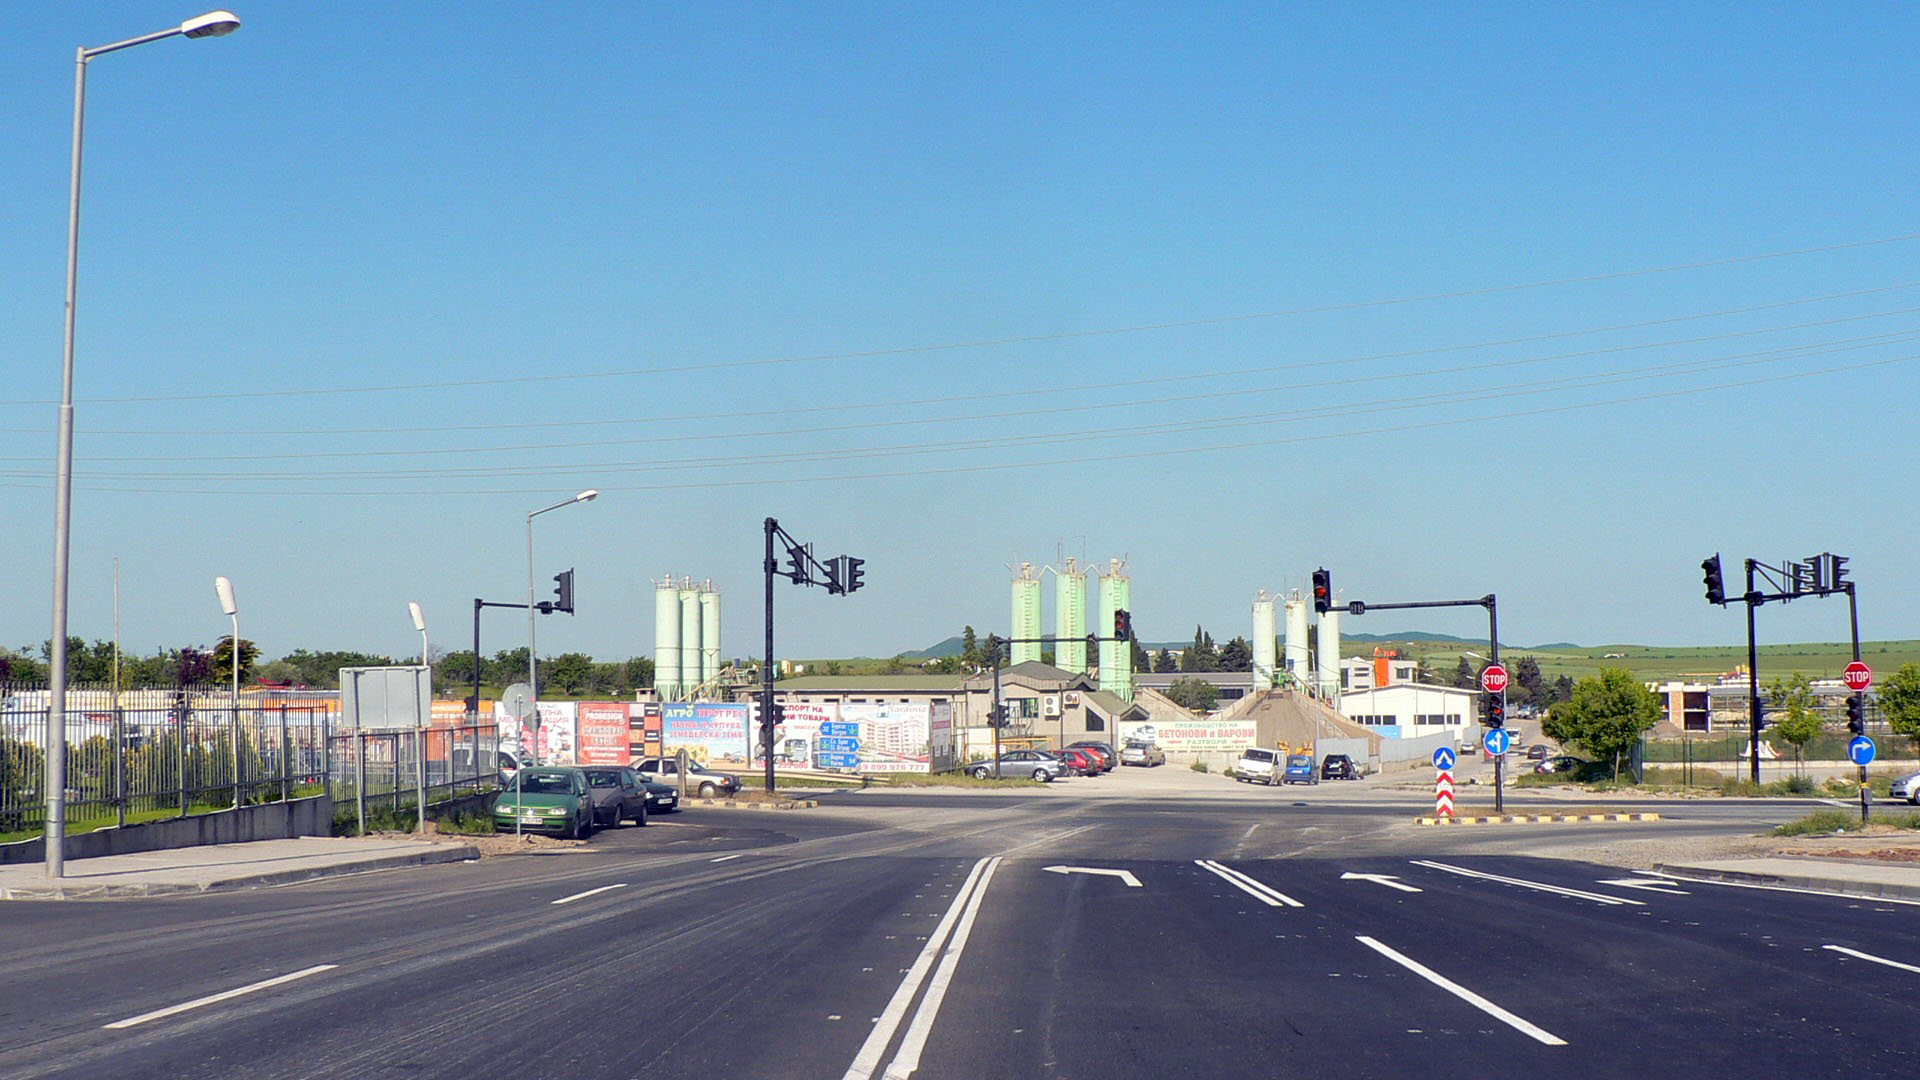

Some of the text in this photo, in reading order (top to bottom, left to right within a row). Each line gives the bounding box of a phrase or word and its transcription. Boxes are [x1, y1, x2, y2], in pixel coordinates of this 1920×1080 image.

[1484, 674, 1506, 685] STOP
[1845, 671, 1869, 683] STOP
[798, 713, 831, 722] ТОВАРИ
[1158, 729, 1207, 738] БЕТОНОВИ
[1217, 728, 1255, 737] ВАРОВИ
